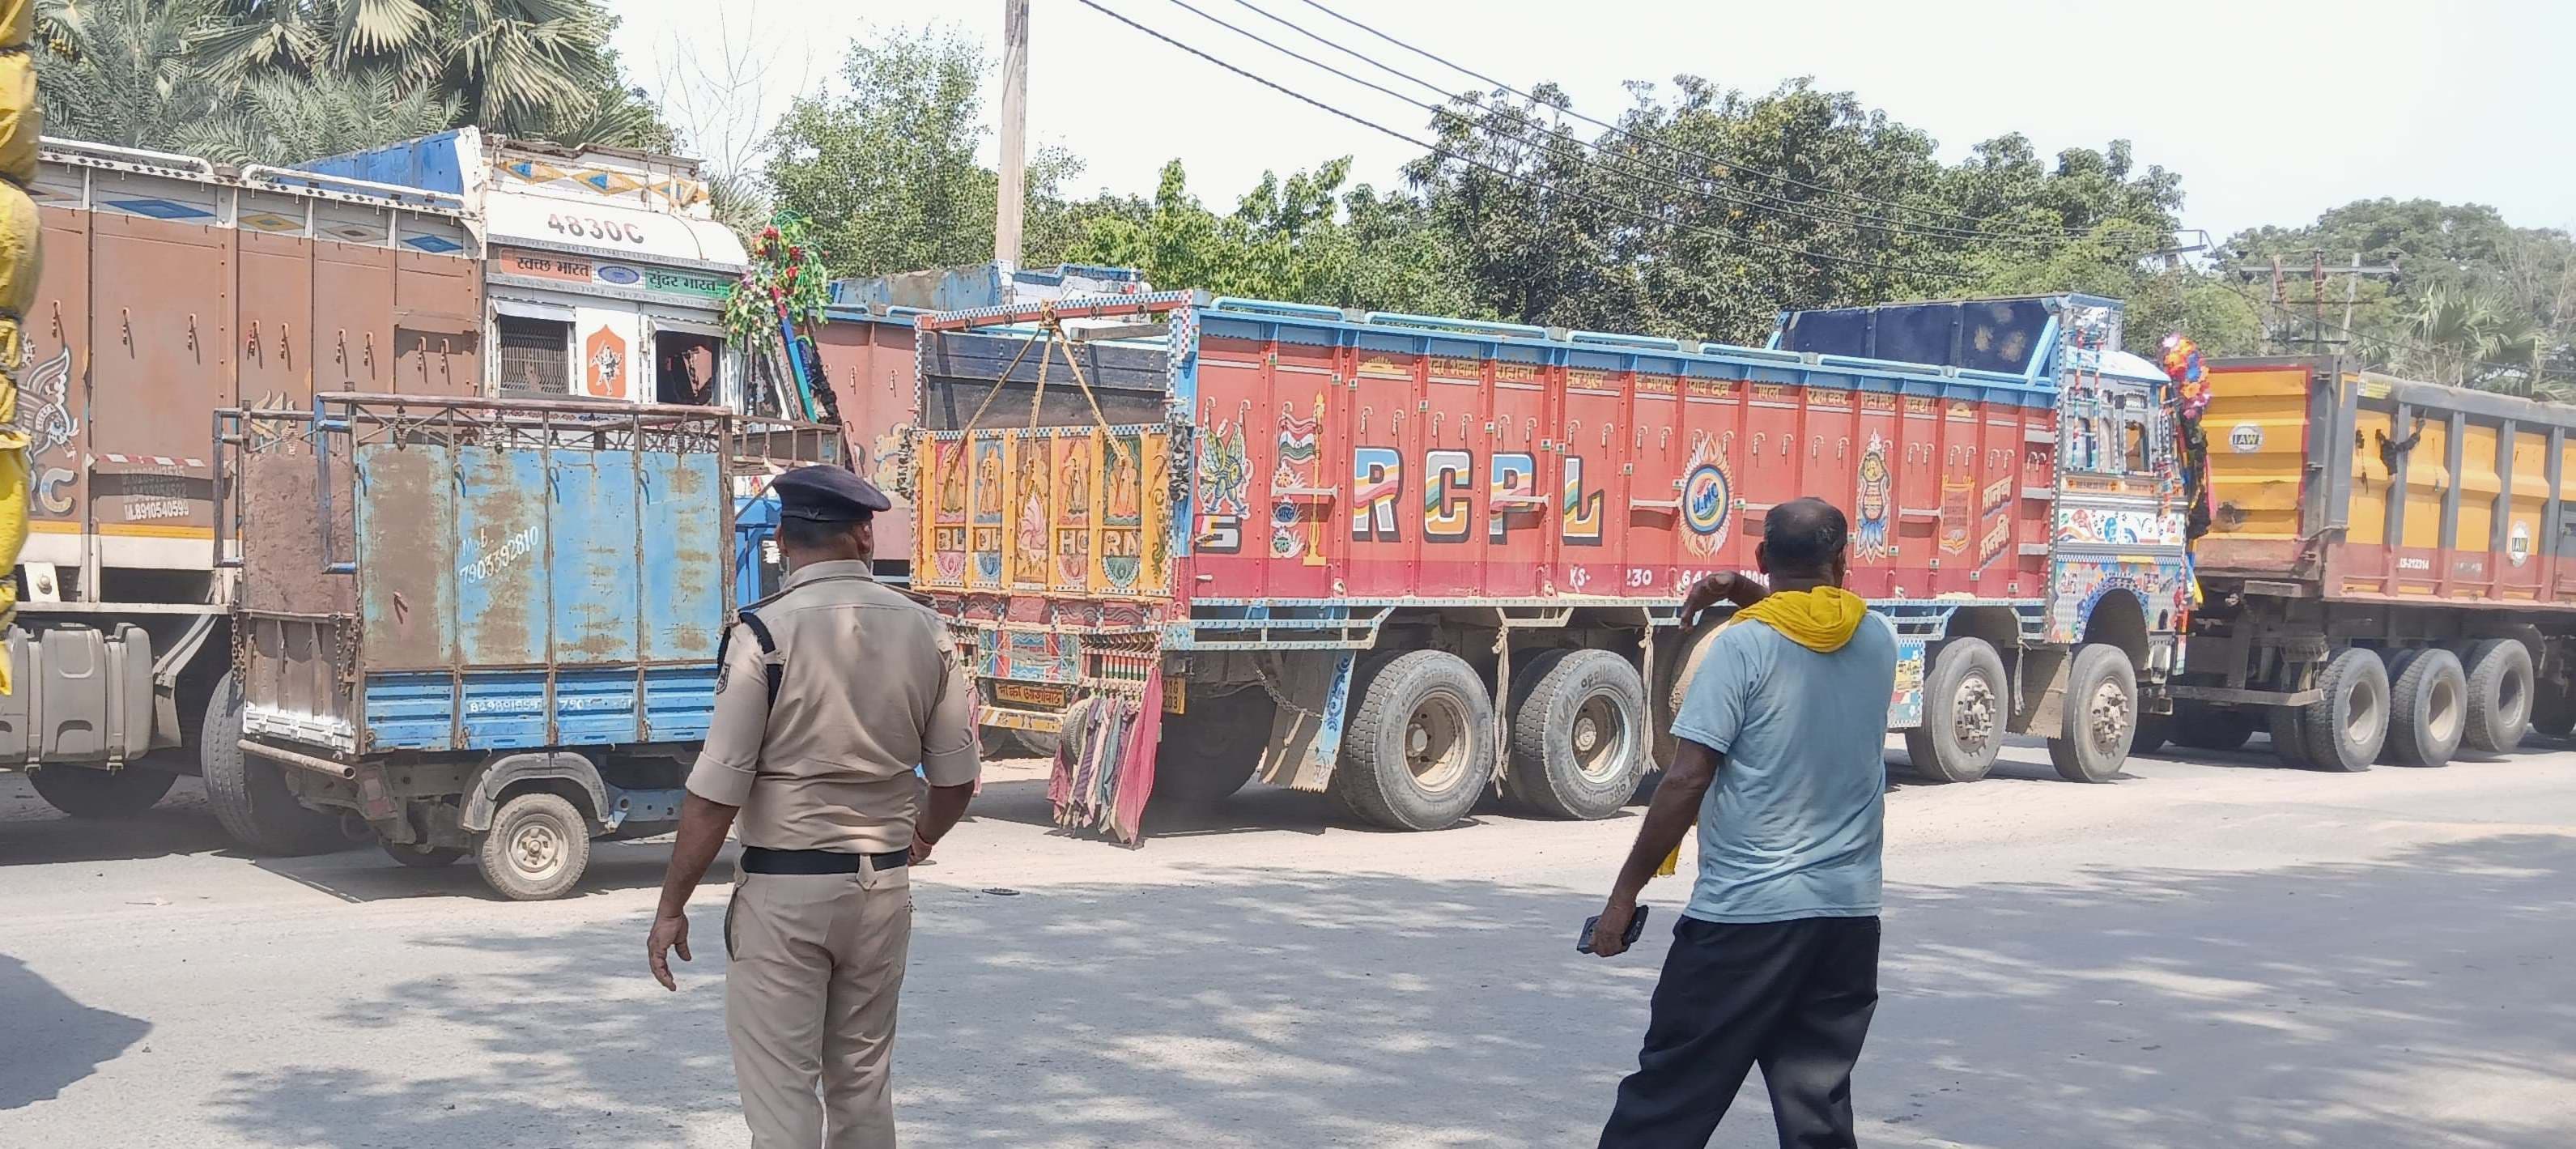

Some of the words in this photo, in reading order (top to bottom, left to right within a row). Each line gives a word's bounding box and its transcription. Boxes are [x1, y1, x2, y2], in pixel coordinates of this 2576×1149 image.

[548, 213, 644, 244] 4830C
[516, 256, 551, 273] स्वच्छ
[556, 259, 592, 277] भारत
[648, 272, 678, 290] सुंदर
[682, 277, 716, 292] भारत
[1352, 446, 1605, 547] RCPL
[459, 526, 539, 586] 7903392810
